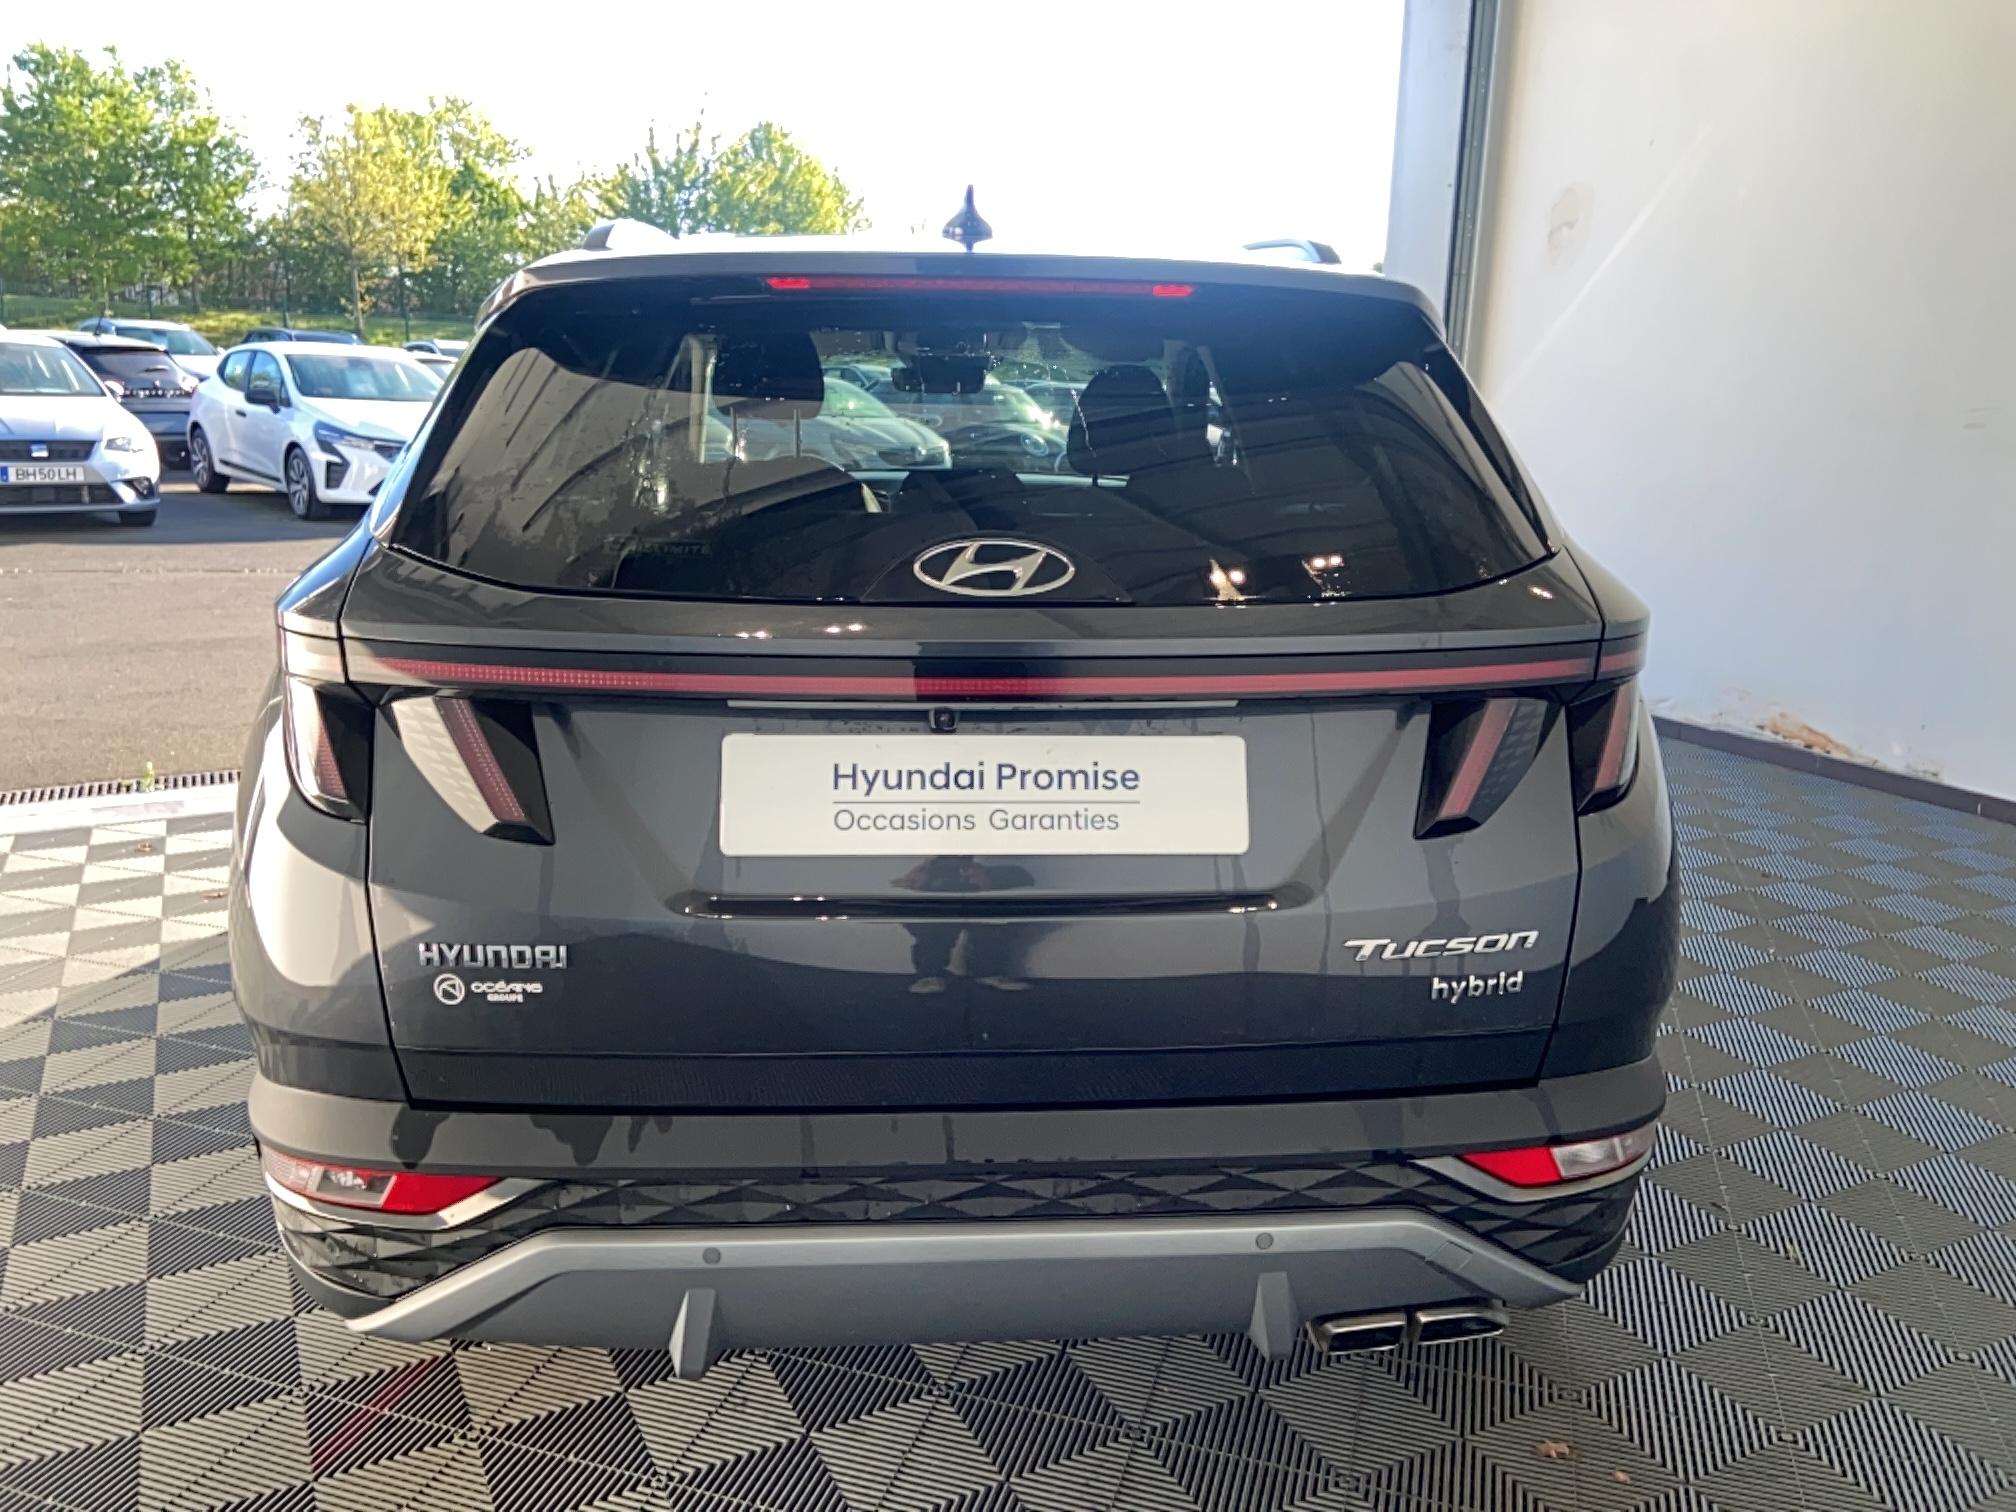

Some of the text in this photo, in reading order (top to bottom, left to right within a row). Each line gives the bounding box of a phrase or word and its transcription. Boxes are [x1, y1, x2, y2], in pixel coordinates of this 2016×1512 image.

[832, 761, 1141, 797] Hyundai Promise
[833, 808, 1120, 831] Occasions Garanties
[418, 943, 568, 969] HYUNDAI
[1430, 970, 1524, 1004] hybrid
